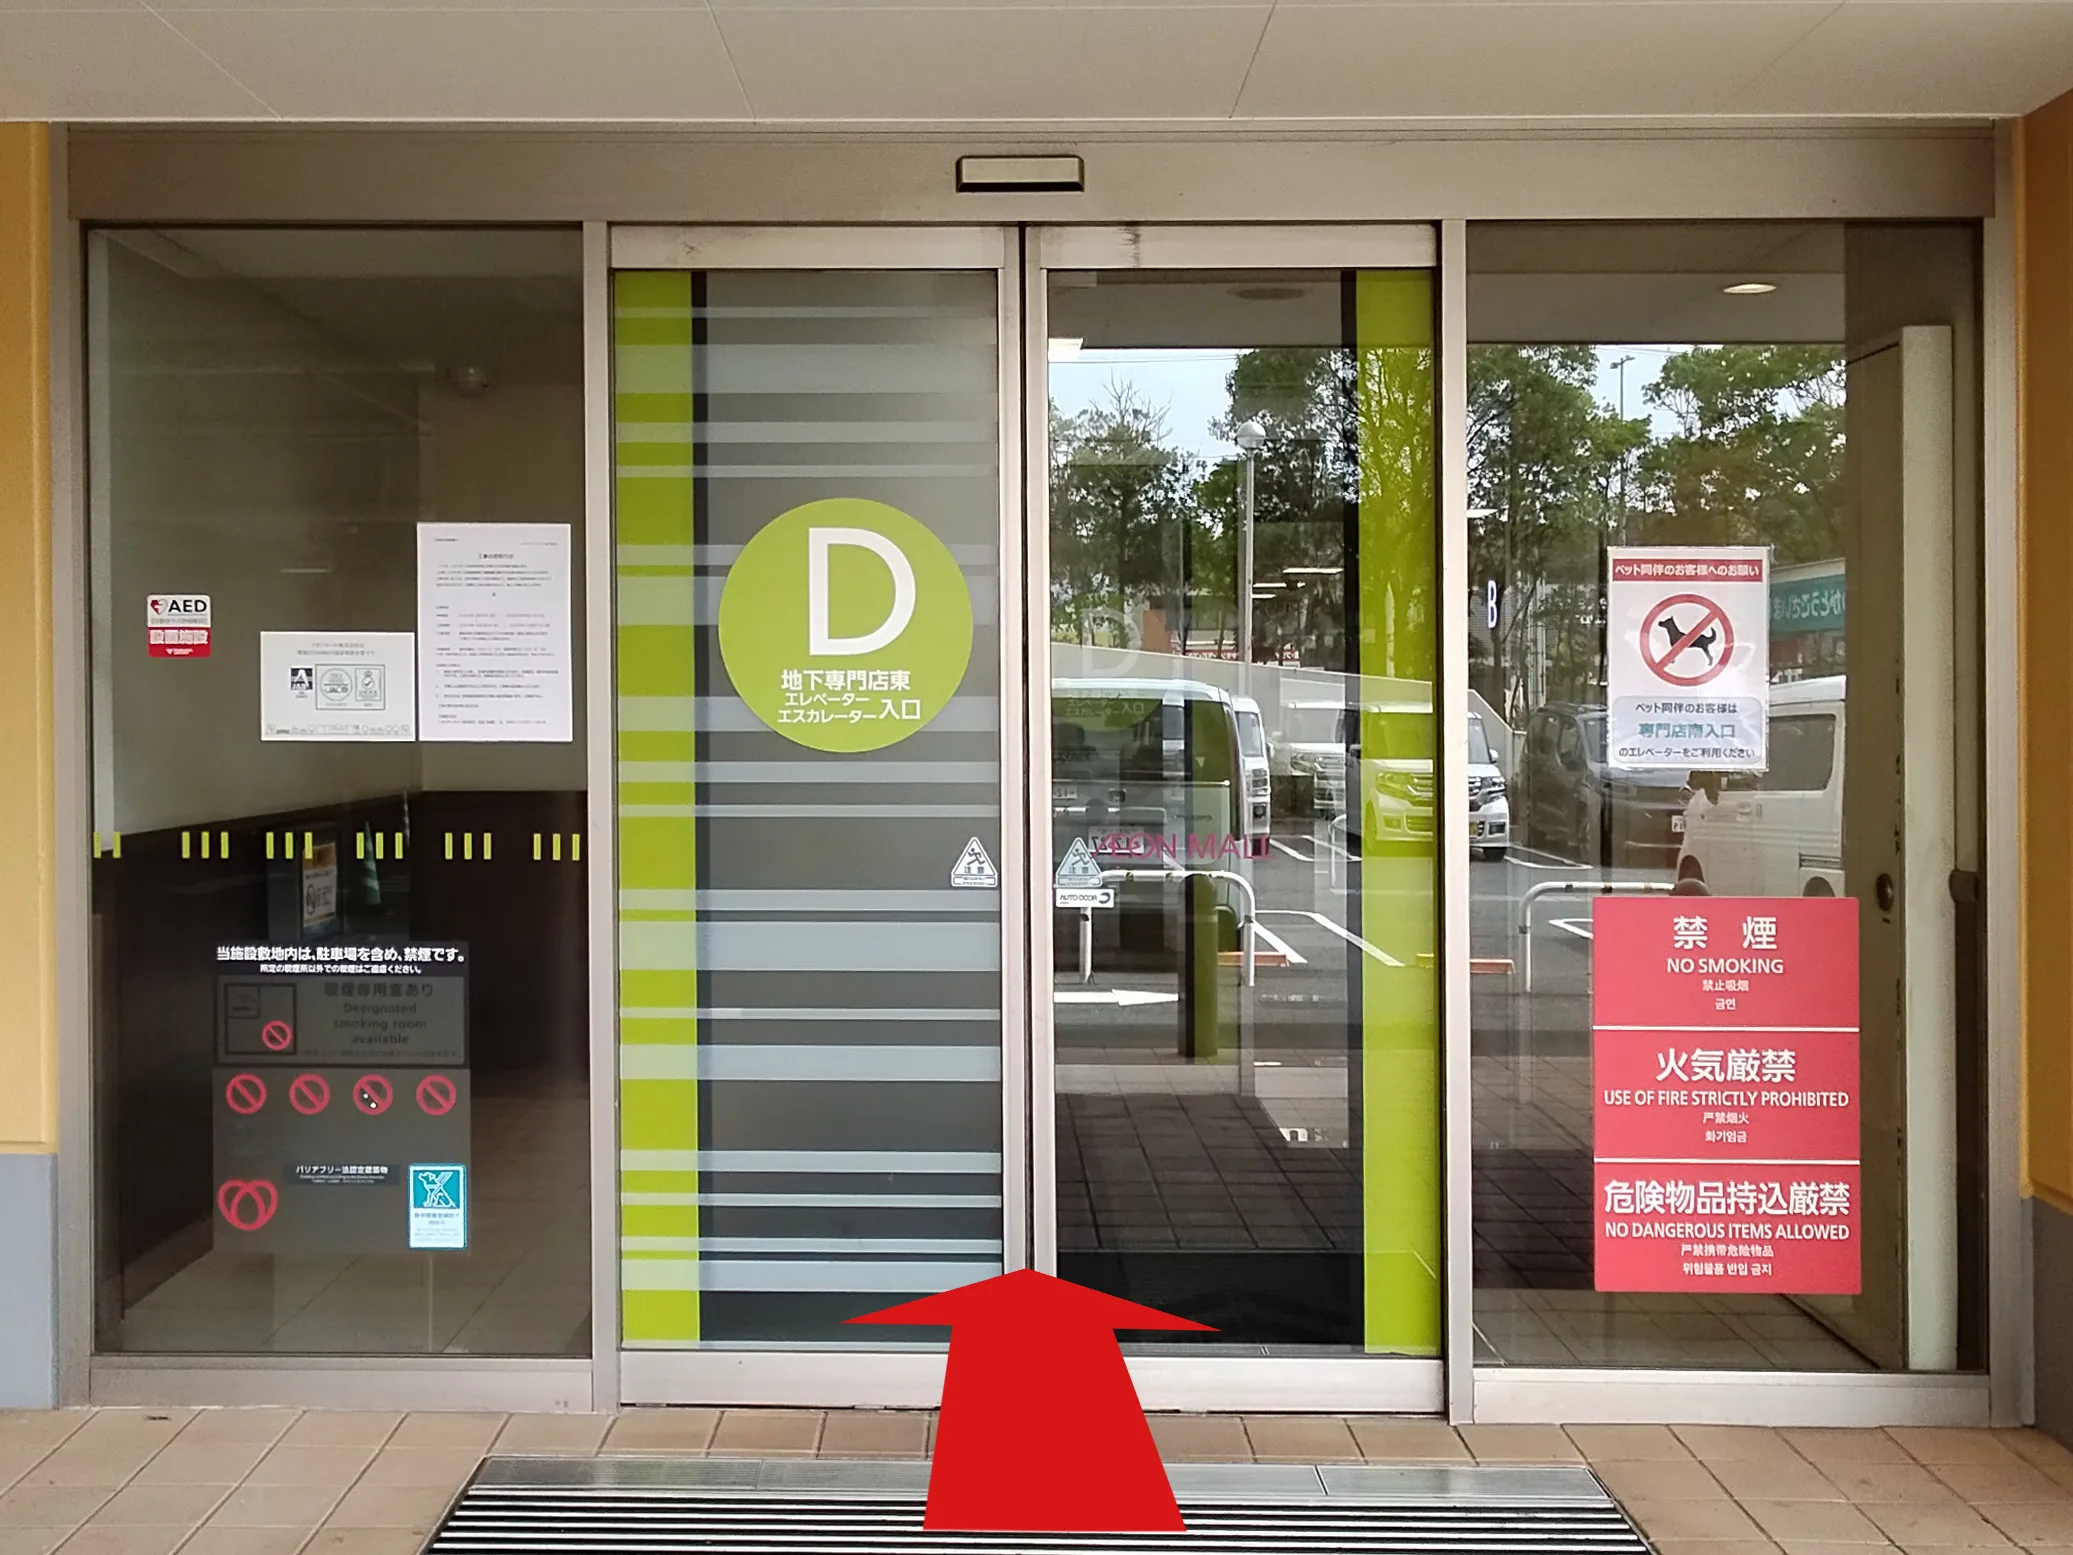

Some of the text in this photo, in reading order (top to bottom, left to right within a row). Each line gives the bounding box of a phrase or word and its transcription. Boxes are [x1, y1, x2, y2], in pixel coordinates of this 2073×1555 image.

[1615, 564, 1760, 577] ペット同伴のお客様へのお願い
[809, 527, 916, 656] D
[168, 600, 207, 613] AED
[781, 669, 911, 691] 地下専門店東
[785, 692, 870, 707] エレベーター
[778, 699, 922, 723] エスカレーター 入口
[1636, 702, 1738, 714] ペット同伴のお客様は
[1639, 723, 1736, 739] 専門店南入口
[216, 946, 465, 962] 当施設敷地内は、駐車場を含め、禁煙です。
[1667, 959, 1784, 974] NO SMOKING
[1702, 979, 1749, 992] 禁止吸烟
[343, 1002, 417, 1016] Designated
[1715, 998, 1737, 1010] 금연
[333, 1018, 427, 1031] smoking room
[351, 1032, 411, 1045] available
[1656, 1048, 1796, 1083] 火気厳禁
[1604, 1090, 1849, 1108] USE OF FIRE STRICTLY PROHIBITED
[1702, 1111, 1750, 1125] 严禁烟火
[1705, 1130, 1748, 1143] 화기엄금
[1604, 1180, 1850, 1216] 危険物品持込厳禁
[1606, 1222, 1850, 1240] NO DANGEROUS ITEMS ALLOWED
[1727, 1263, 1749, 1276] 반입
[1751, 1263, 1773, 1276] 금지
